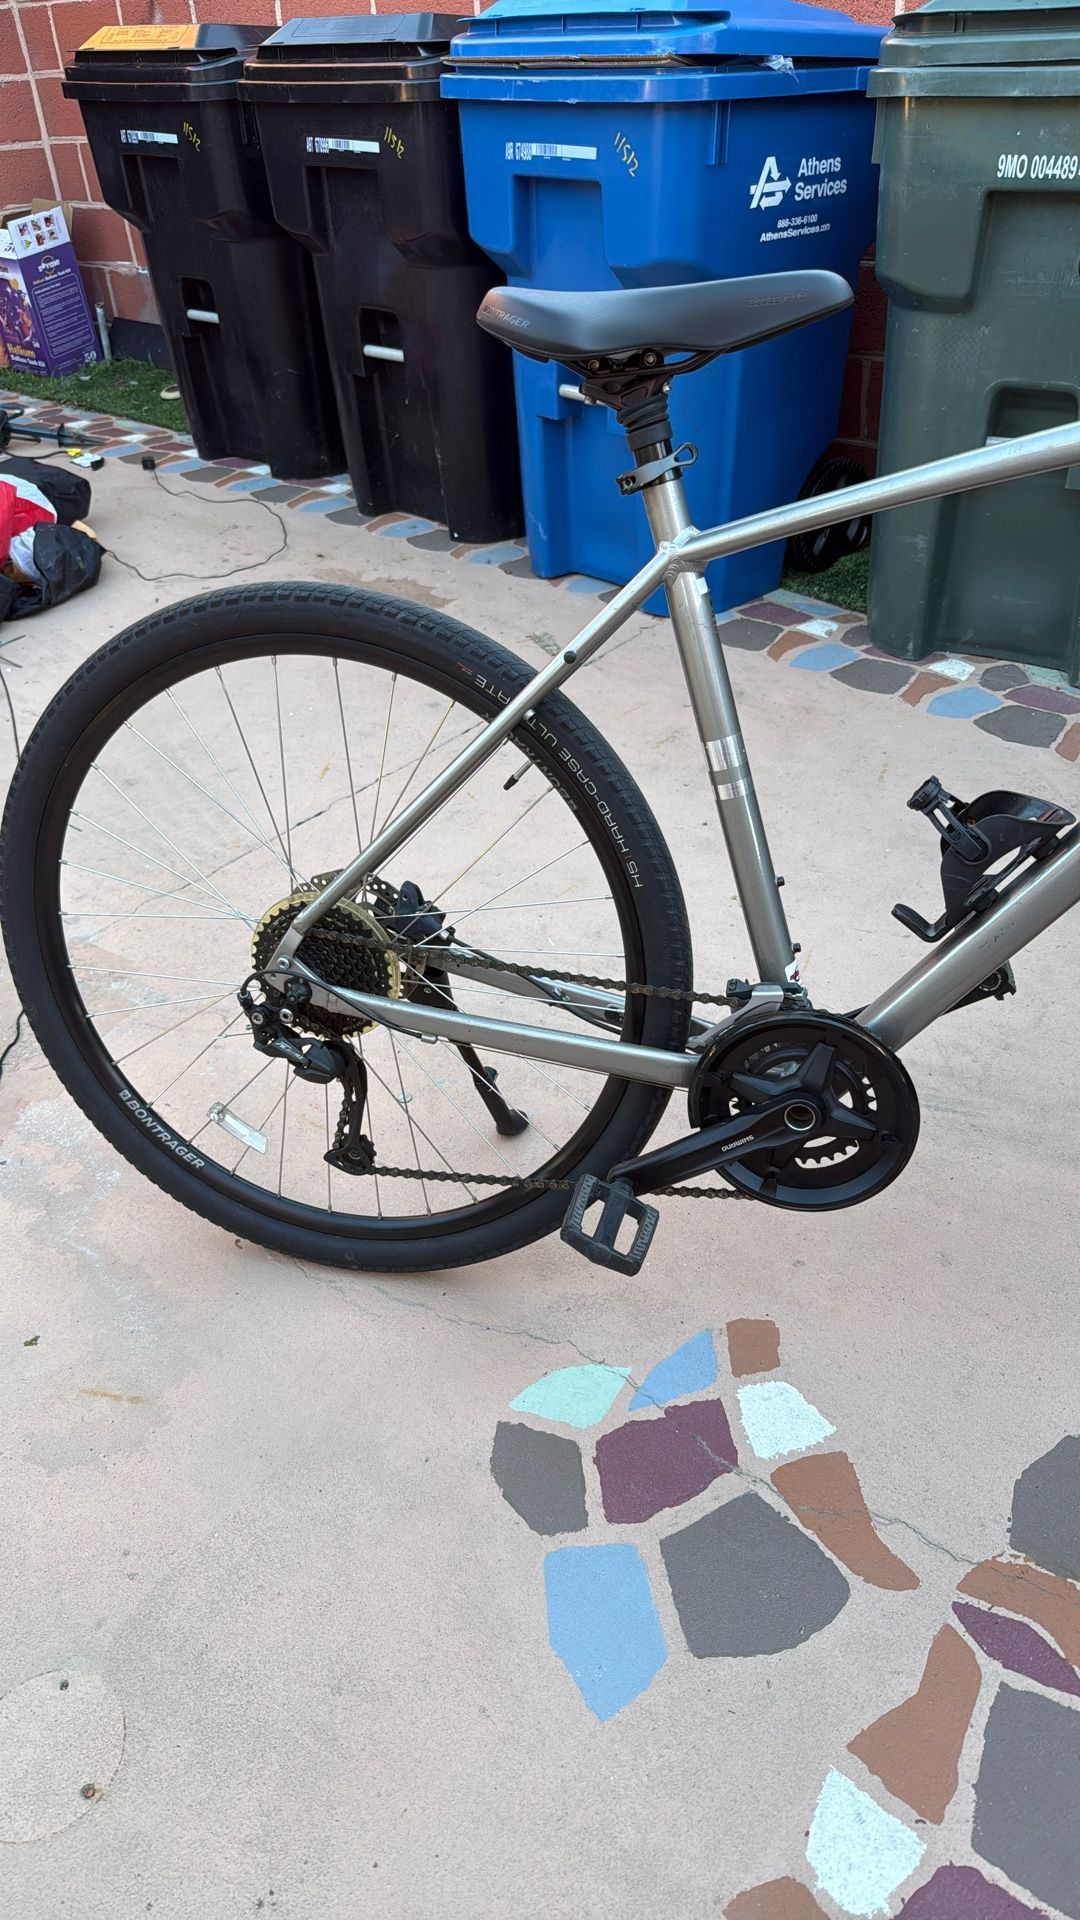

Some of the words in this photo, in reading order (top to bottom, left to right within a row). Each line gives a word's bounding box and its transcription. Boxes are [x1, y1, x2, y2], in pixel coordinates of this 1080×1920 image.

[797, 156, 842, 178] Athens
[996, 153, 1028, 179] 9MO
[1030, 154, 1080, 180] 004489
[794, 178, 848, 202] Services
[777, 213, 818, 229] 888-336-6100
[759, 223, 831, 243] AthensServices.com
[557, 747, 629, 853] HARD-CASE
[125, 1100, 205, 1169] BONTRAGER
[720, 1134, 755, 1152] SHIMANO
